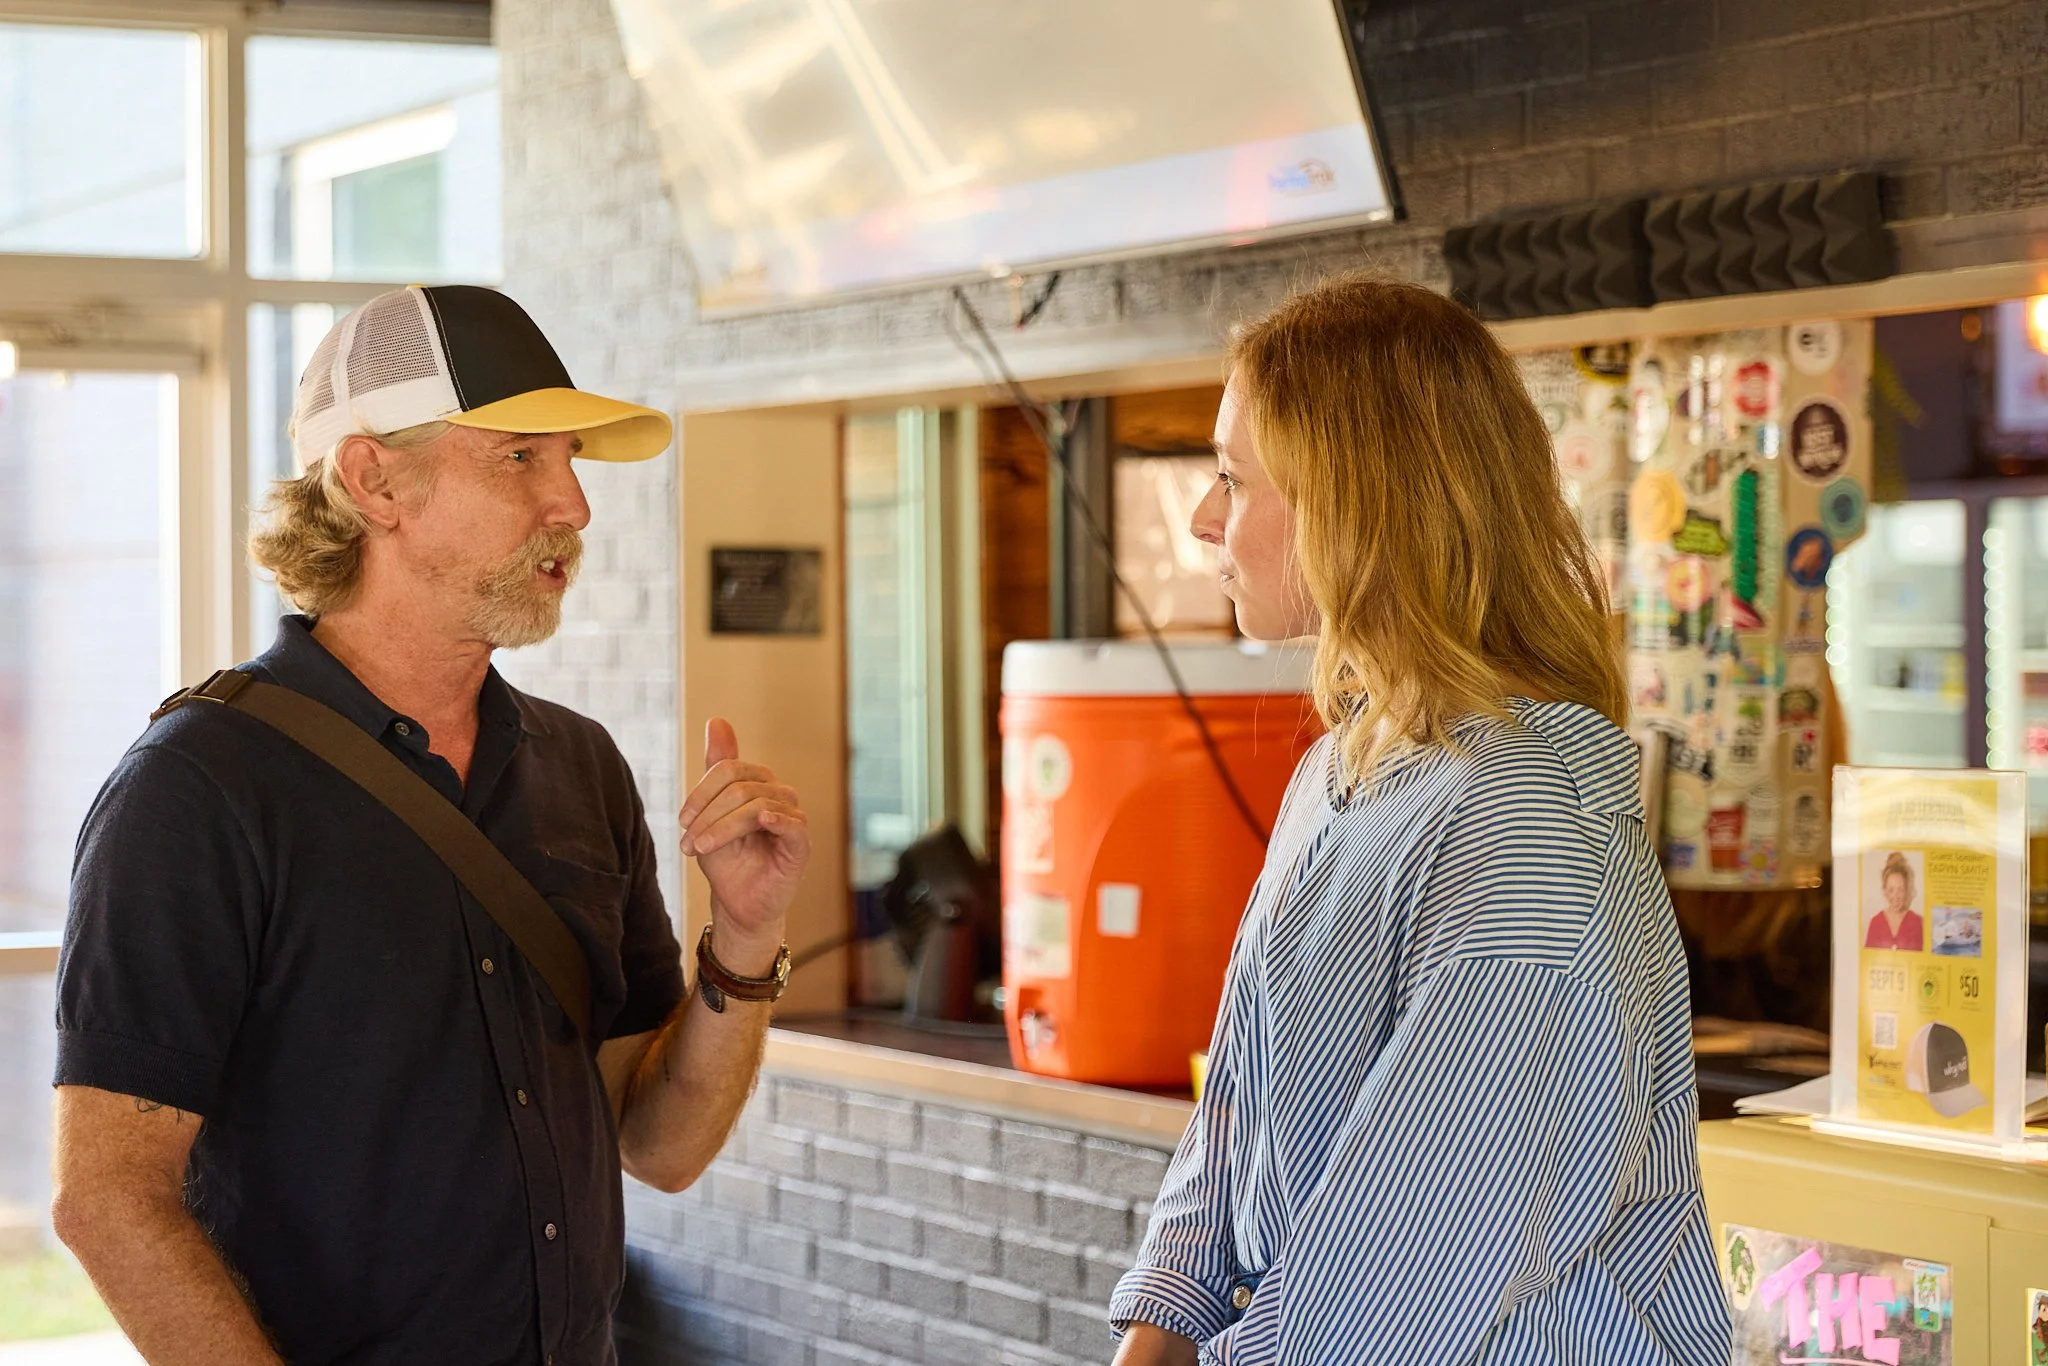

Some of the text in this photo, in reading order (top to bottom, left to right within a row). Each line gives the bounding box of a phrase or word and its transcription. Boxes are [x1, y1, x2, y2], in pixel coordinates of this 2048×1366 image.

[1960, 863, 1990, 877] SMITH
[1870, 970, 1905, 992] SEPT 9
[1960, 975, 1979, 998] $50
[1760, 1246, 1901, 1366] THE
